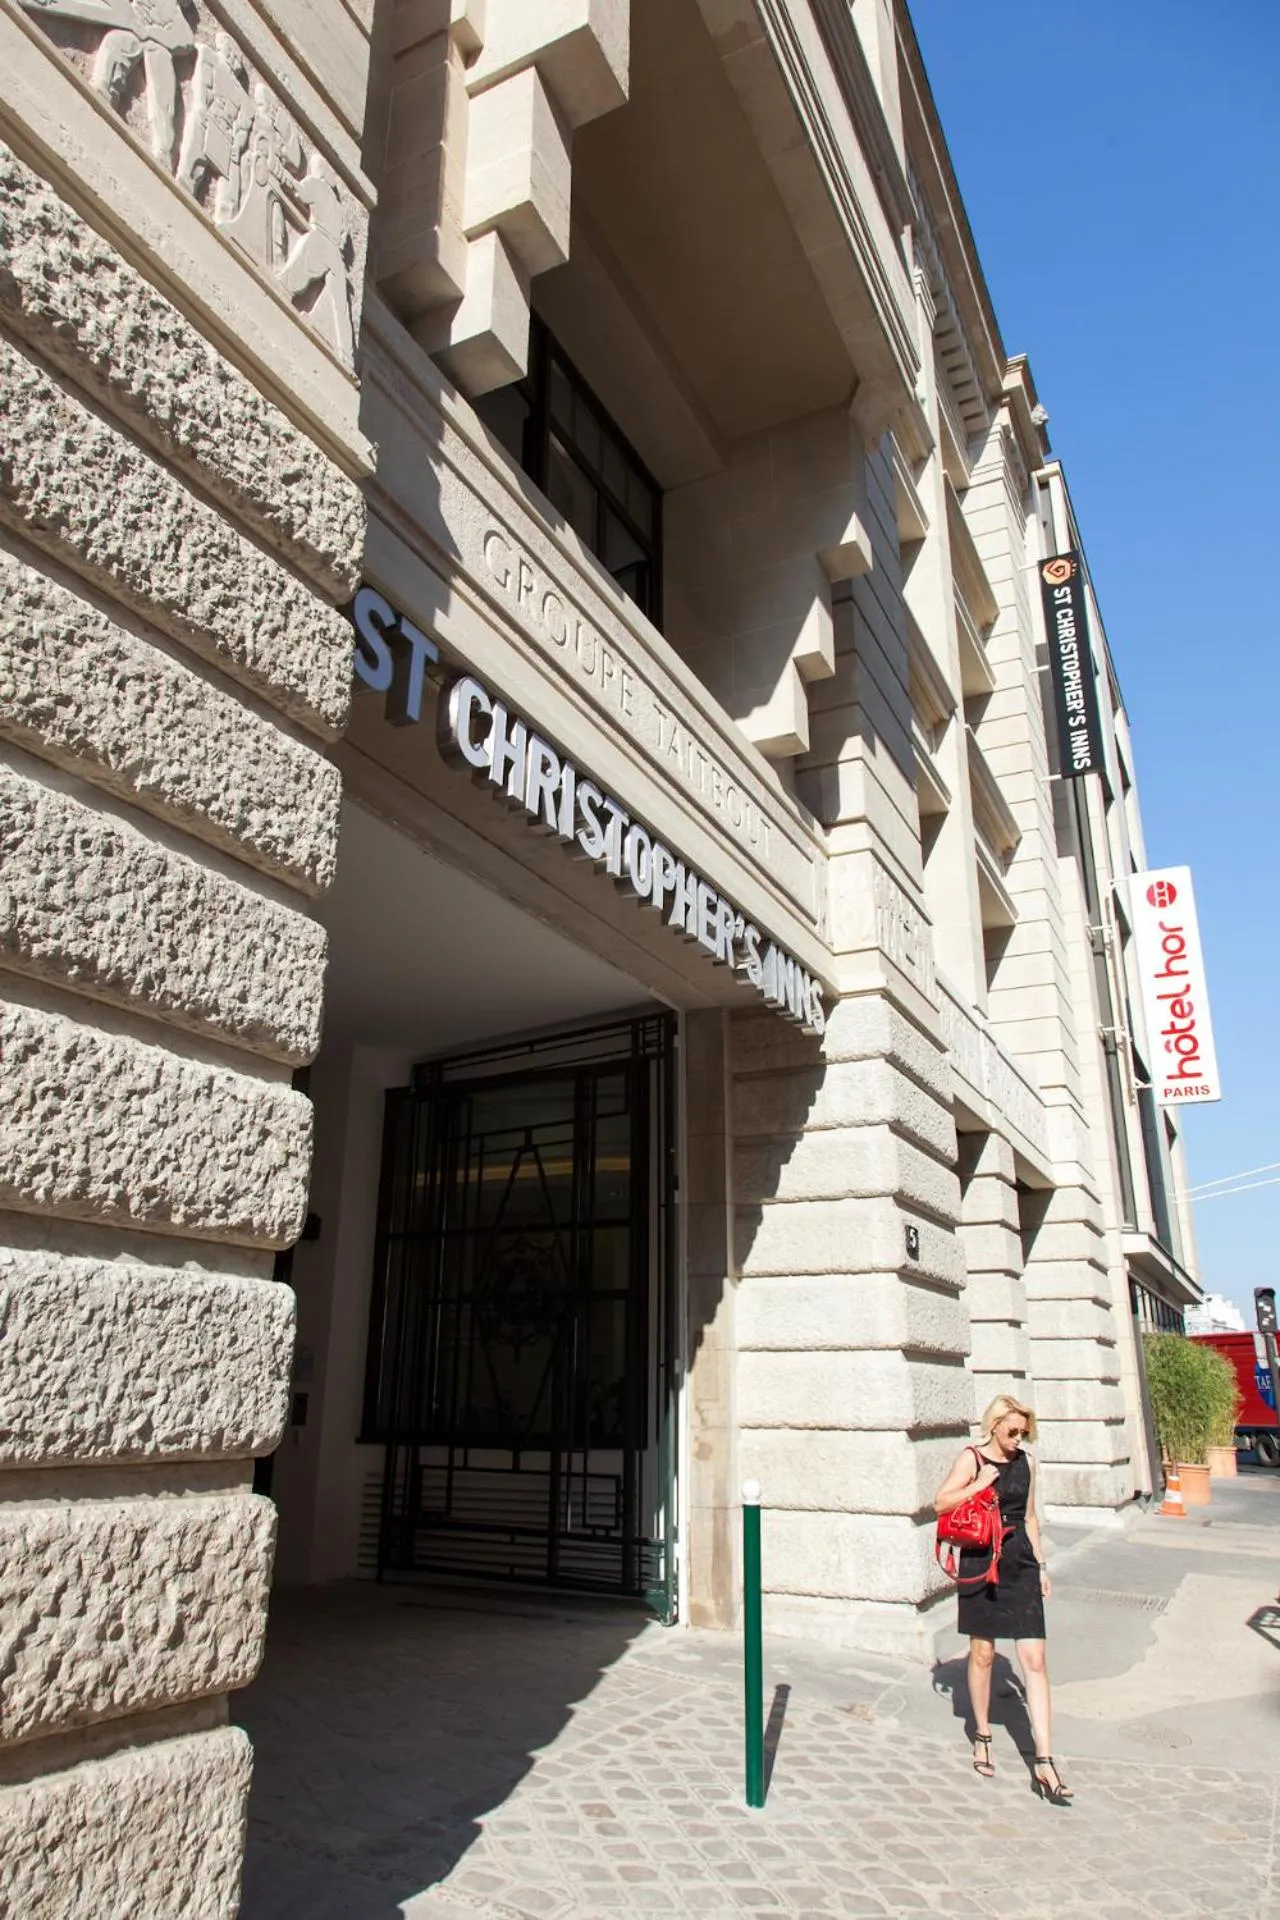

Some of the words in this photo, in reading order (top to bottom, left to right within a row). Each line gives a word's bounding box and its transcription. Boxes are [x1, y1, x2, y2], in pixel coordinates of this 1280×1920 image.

[1053, 586, 1073, 604] ST
[482, 529, 634, 716] GROUPE
[652, 703, 773, 855] TAITBOUT
[1056, 608, 1086, 727] CHRISTOPHER'S
[1069, 731, 1091, 771] INNS
[352, 587, 439, 722] ST
[448, 676, 764, 991] CHRISTOPHER'S
[763, 943, 825, 1036] INNS
[1154, 920, 1189, 979] hor
[1157, 983, 1203, 1080] hôtel
[1163, 1084, 1211, 1098] PARIS
